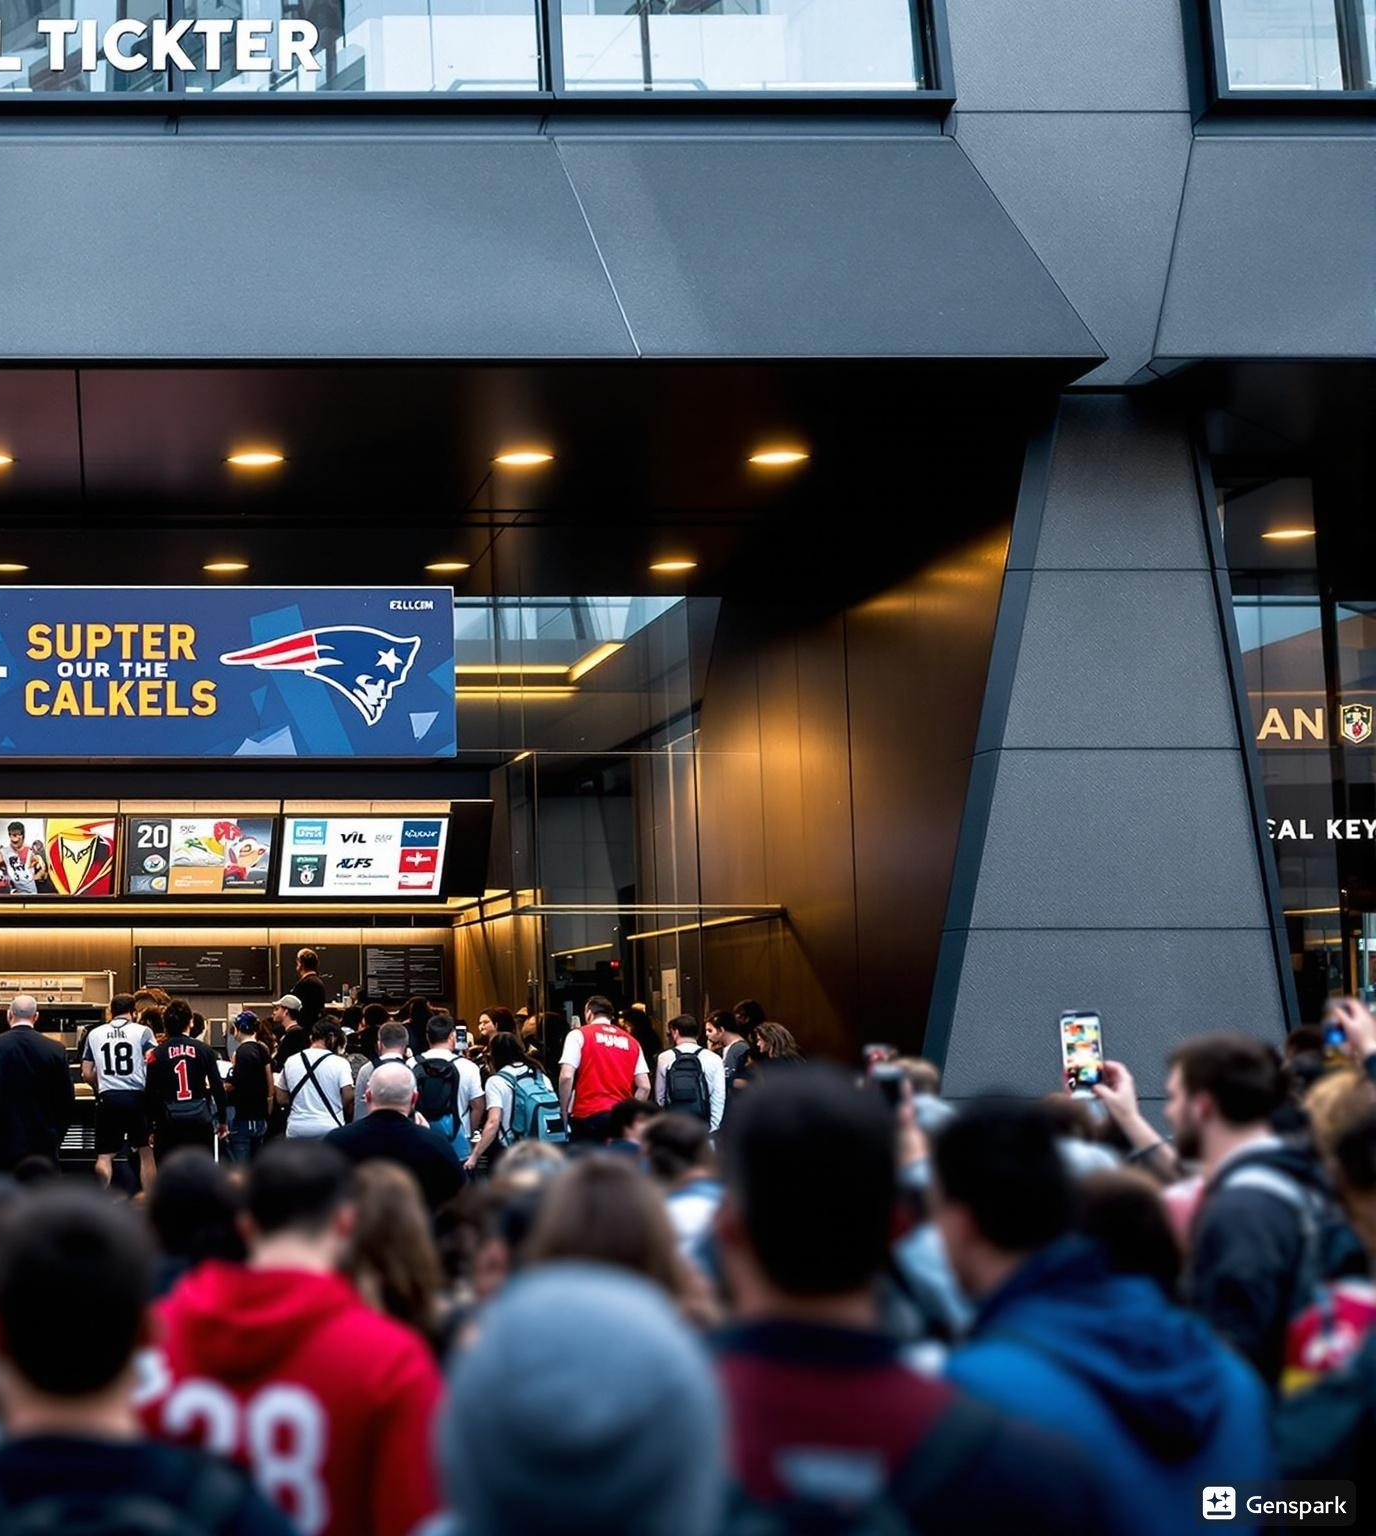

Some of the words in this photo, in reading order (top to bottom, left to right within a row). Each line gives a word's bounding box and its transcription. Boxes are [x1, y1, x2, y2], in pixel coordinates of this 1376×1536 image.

[37, 19, 322, 72] TICKTER
[26, 623, 197, 660] SUPTER
[57, 661, 110, 678] OUR
[119, 661, 168, 678] THE
[25, 679, 217, 717] CALKELS
[1256, 708, 1324, 740] AN
[137, 825, 169, 849] 20
[1326, 819, 1376, 840] KEY
[100, 1041, 133, 1076] 18
[174, 1059, 192, 1101] 1
